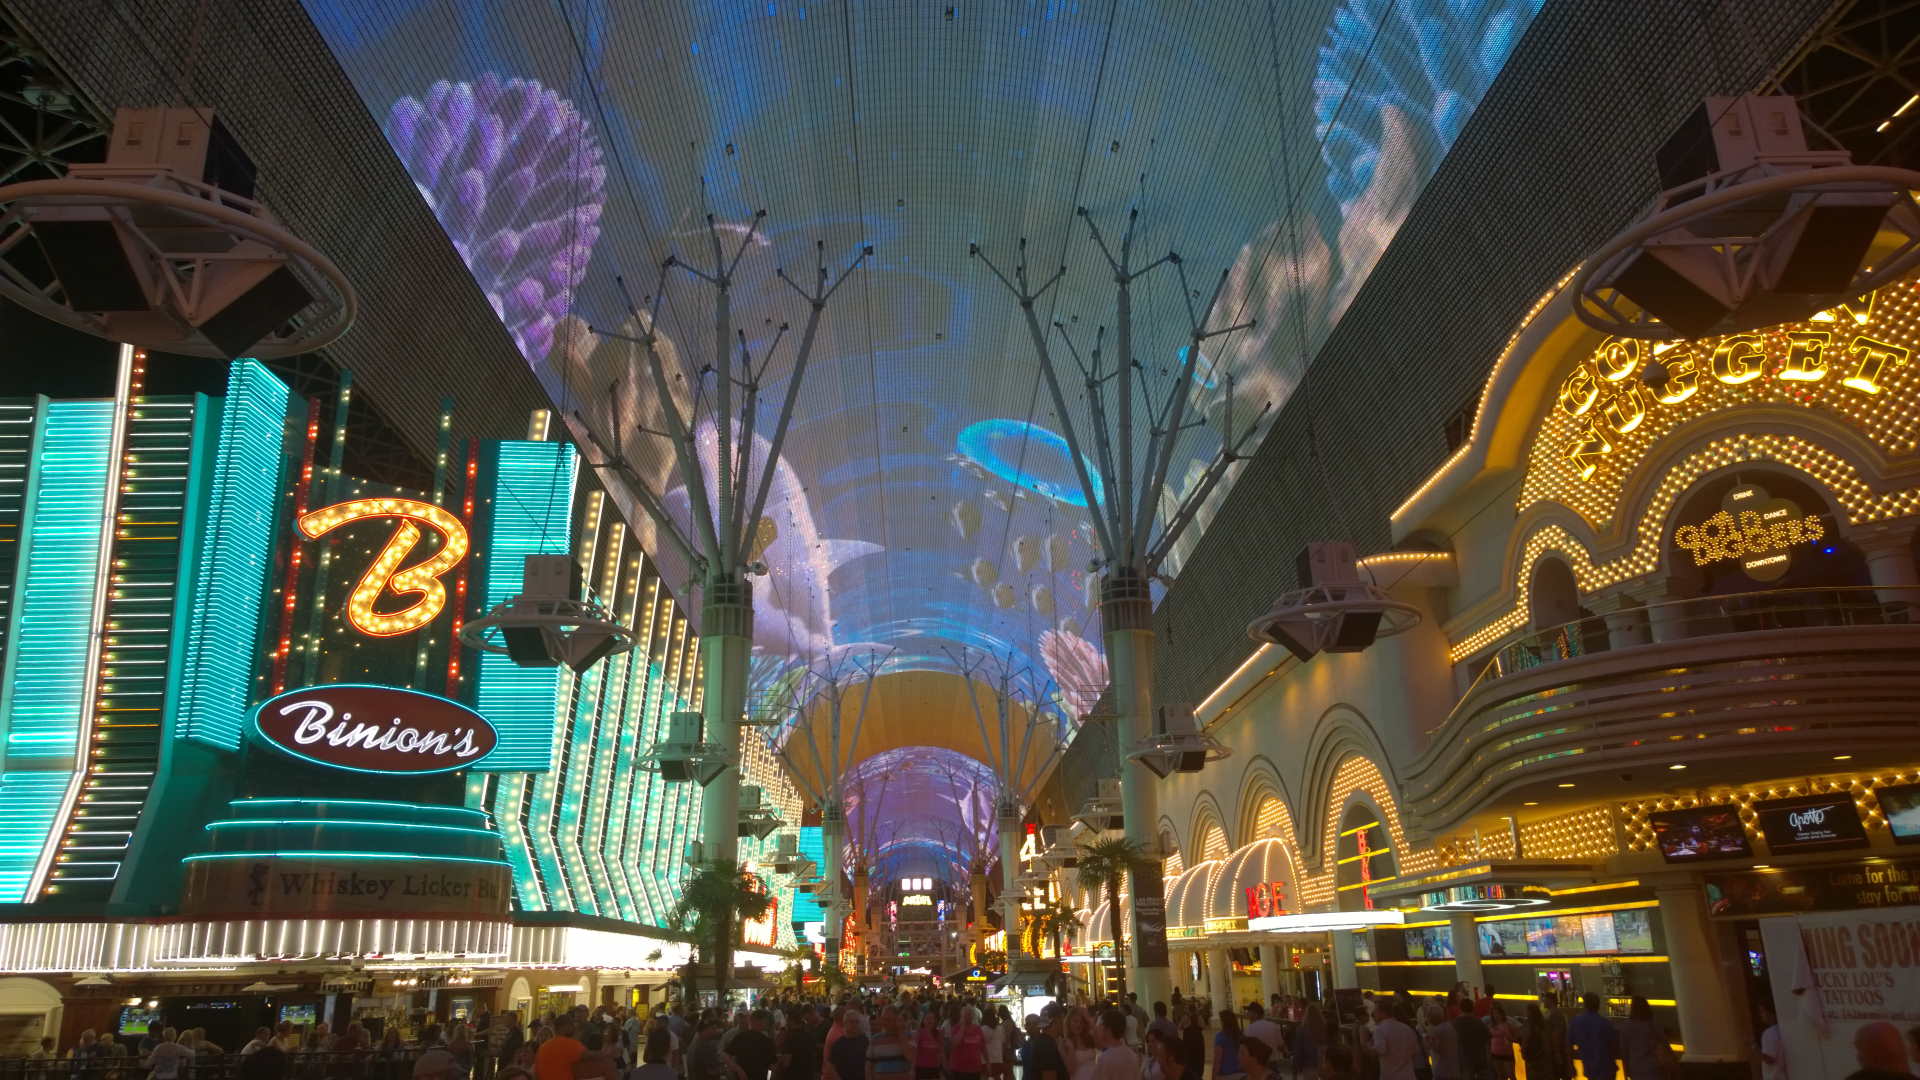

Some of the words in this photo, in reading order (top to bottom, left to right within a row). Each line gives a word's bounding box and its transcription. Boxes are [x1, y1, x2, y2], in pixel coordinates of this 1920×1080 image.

[1562, 331, 1910, 481] NUGGET
[1732, 490, 1755, 501] DRINK
[1763, 508, 1788, 520] DANCE
[1674, 510, 1761, 550] GOLD
[1692, 514, 1824, 567] DIGGERS
[298, 497, 468, 637] B
[1745, 554, 1788, 569] DOWNTOWN
[280, 701, 479, 757] Binion's
[280, 871, 394, 900] Whiskey
[402, 873, 471, 898] Licker
[1865, 866, 1884, 885] for
[1814, 972, 1847, 988] UCKY
